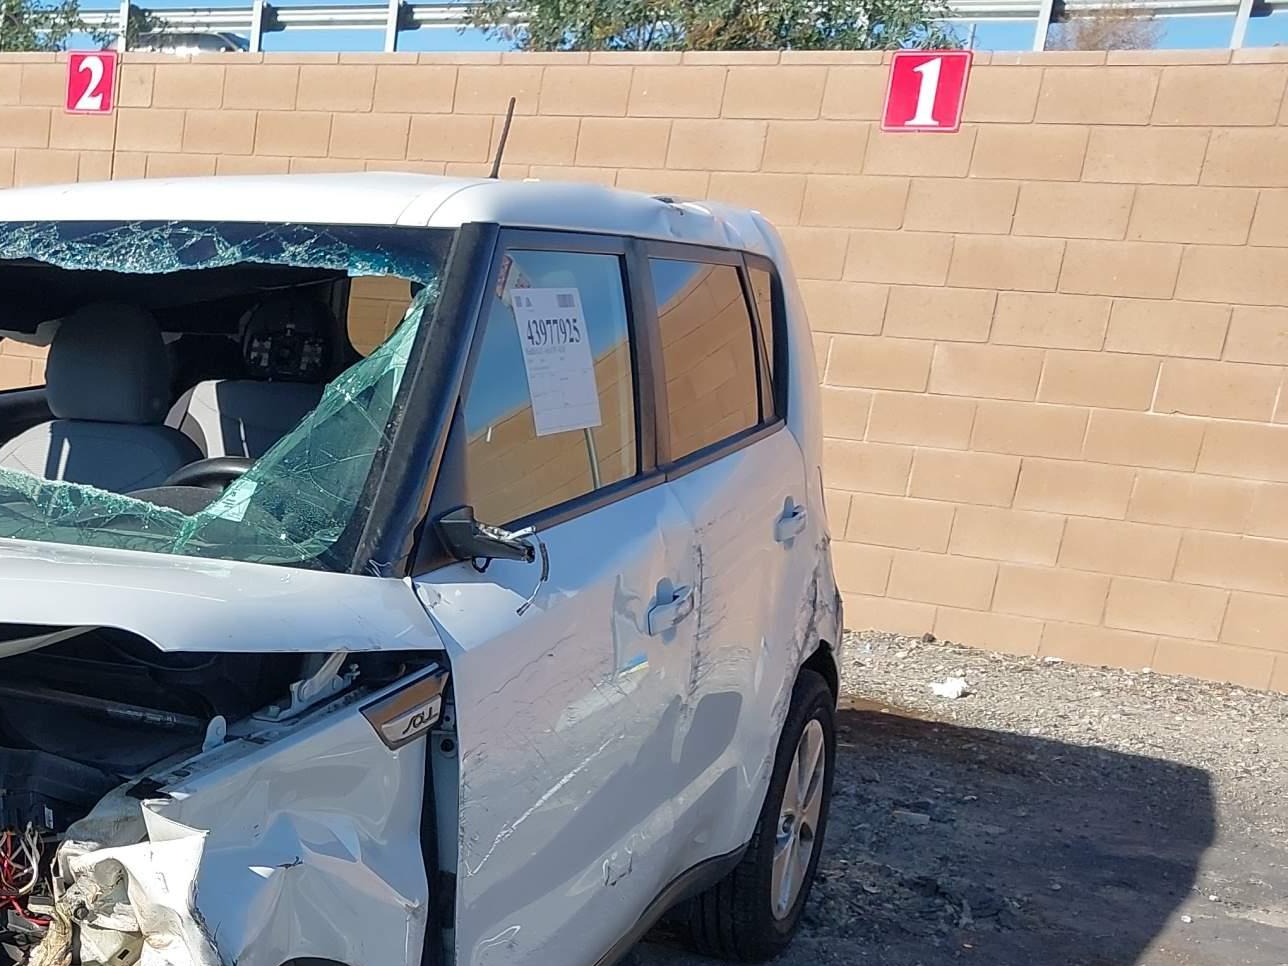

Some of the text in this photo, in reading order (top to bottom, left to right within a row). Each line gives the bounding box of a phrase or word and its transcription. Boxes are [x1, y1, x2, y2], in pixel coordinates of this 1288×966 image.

[75, 55, 104, 110] 2
[904, 57, 942, 126] 1
[526, 317, 581, 346] 43977925
